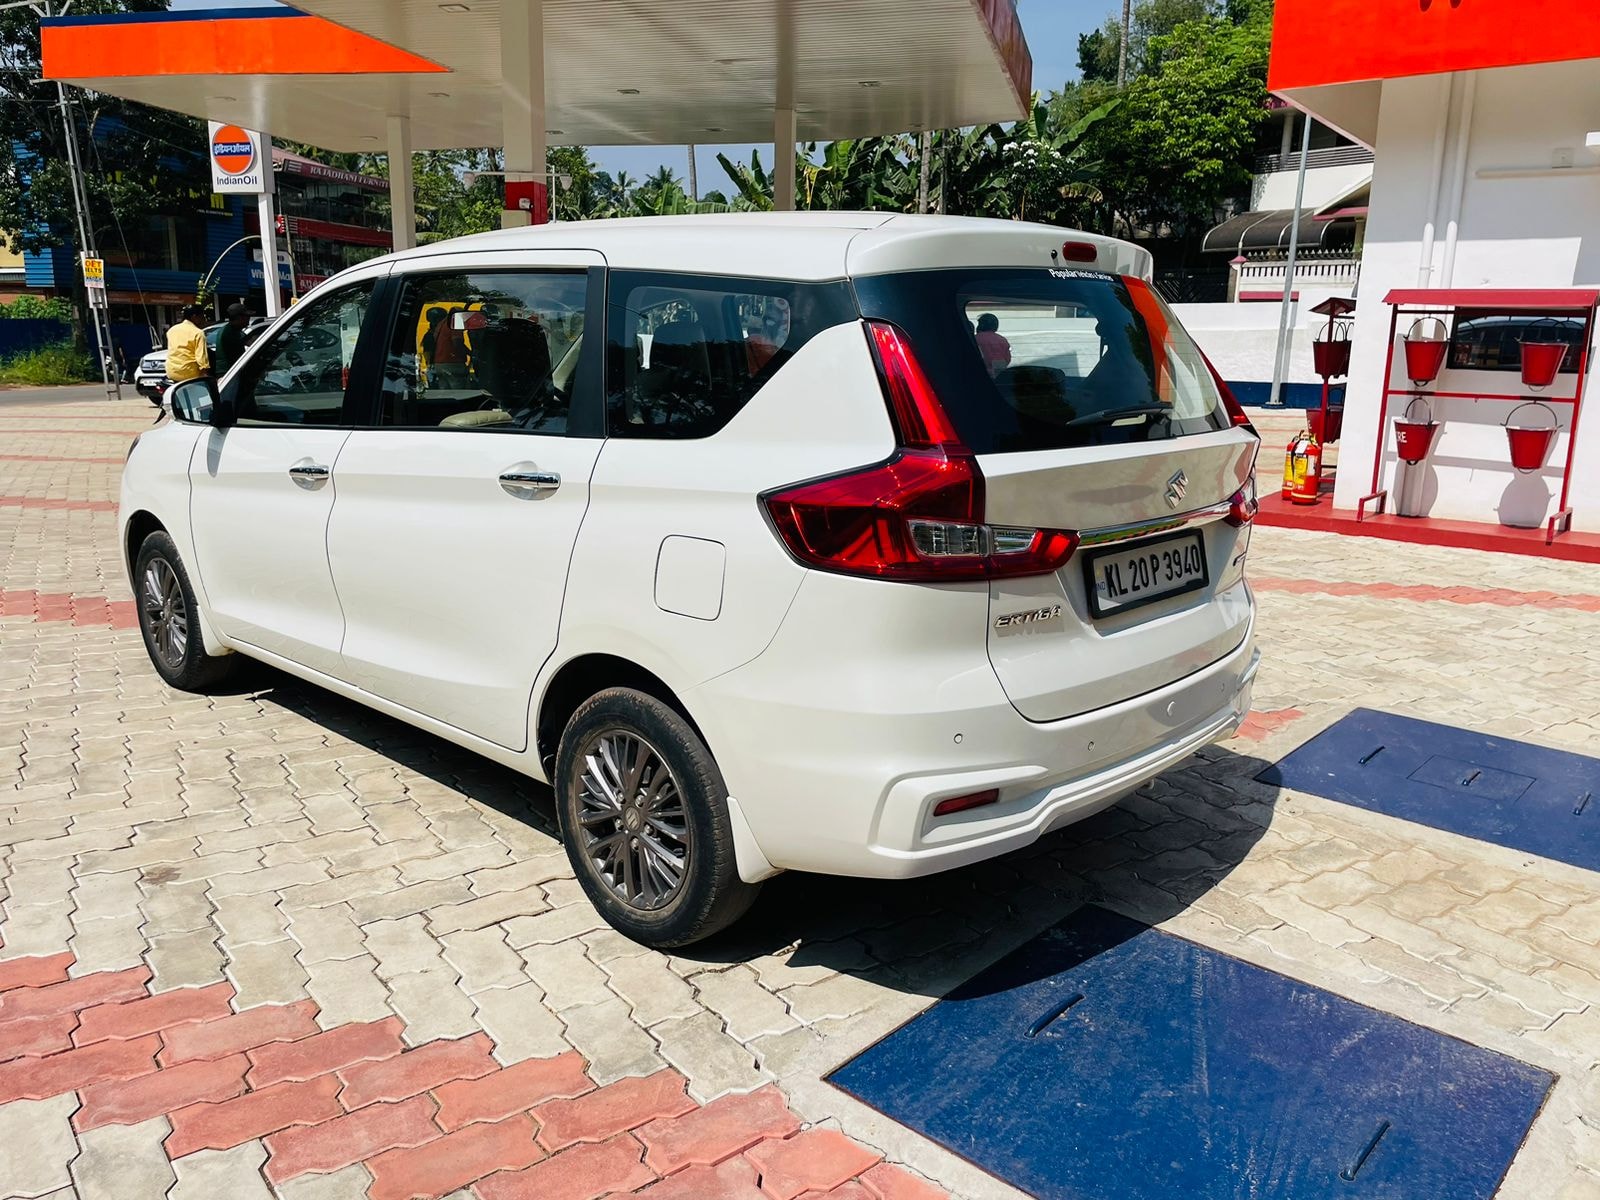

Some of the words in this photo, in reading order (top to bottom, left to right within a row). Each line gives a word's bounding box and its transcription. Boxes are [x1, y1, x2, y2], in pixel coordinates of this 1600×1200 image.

[216, 175, 258, 185] IndianOil
[310, 166, 358, 183] RAJADHANI
[1048, 268, 1078, 280] Popular
[1104, 563, 1129, 598] KL
[1129, 557, 1150, 592] 20
[1149, 553, 1160, 586] P
[1163, 544, 1201, 581] 3940
[994, 604, 1062, 628] ERTIGA
